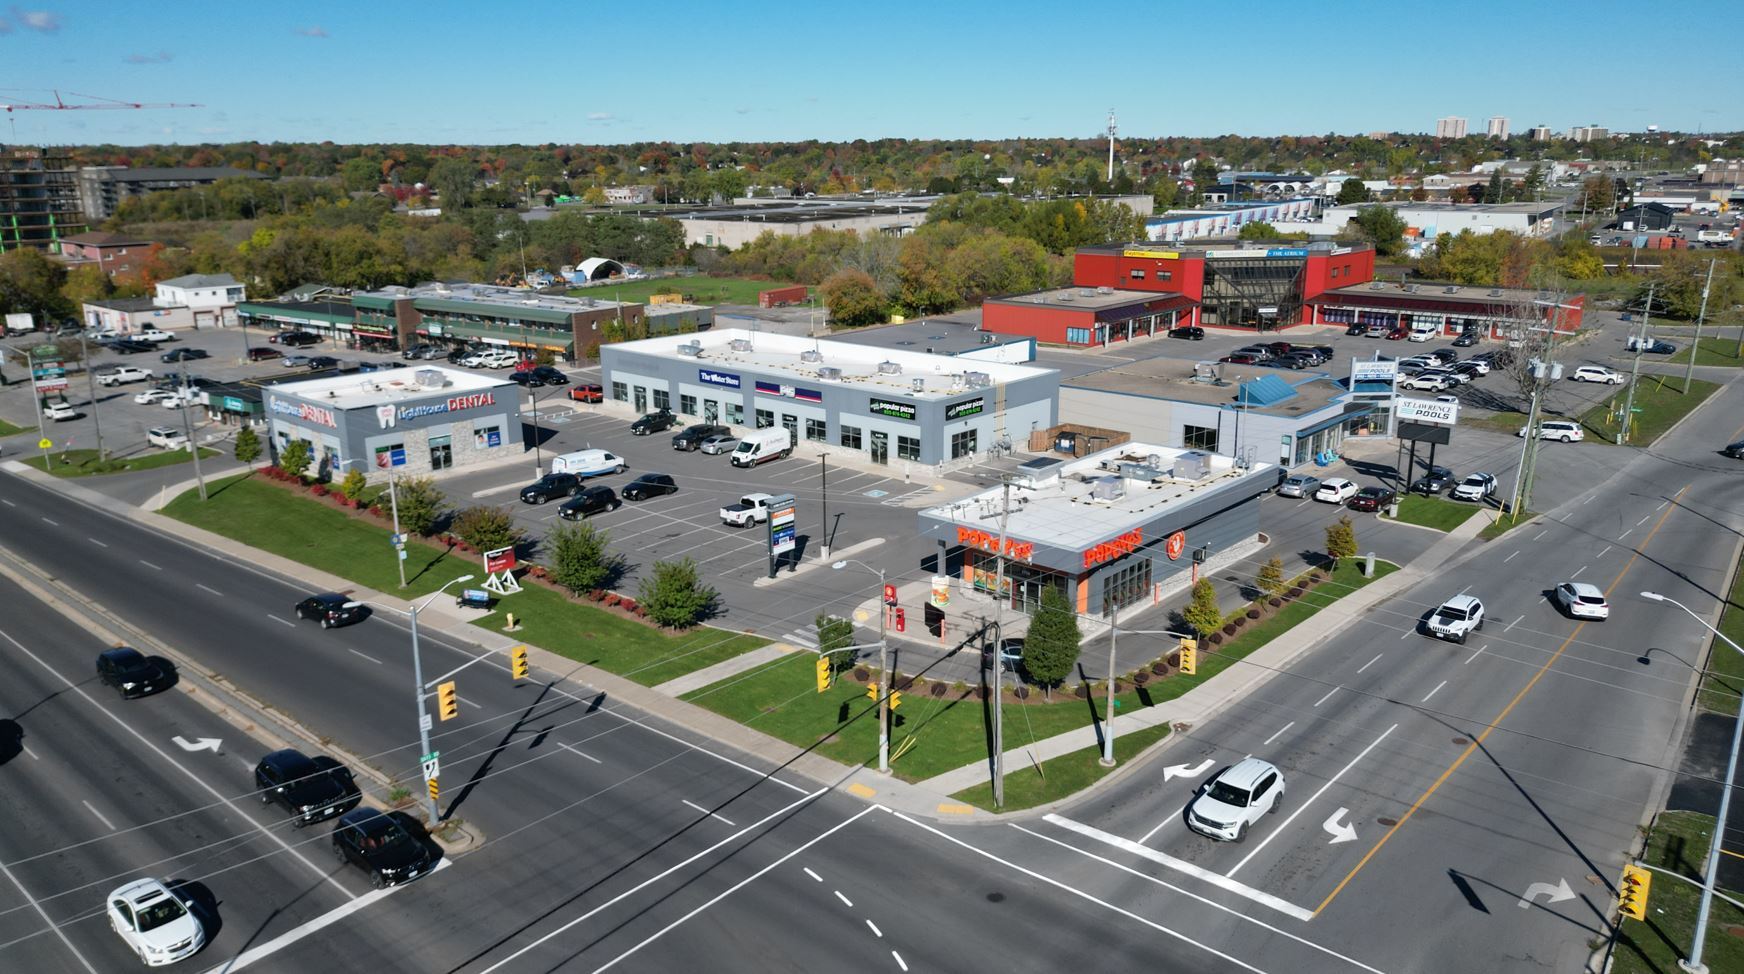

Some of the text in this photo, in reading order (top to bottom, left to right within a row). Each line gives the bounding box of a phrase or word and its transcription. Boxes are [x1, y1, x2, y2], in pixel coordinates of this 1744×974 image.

[448, 392, 496, 412] DENTAL
[880, 402, 900, 412] popular
[900, 405, 915, 414] pizza
[956, 400, 984, 412] popular pizza
[1412, 402, 1453, 414] LAWRENCE
[300, 403, 337, 428] DENTAL
[1416, 410, 1450, 420] POOLS
